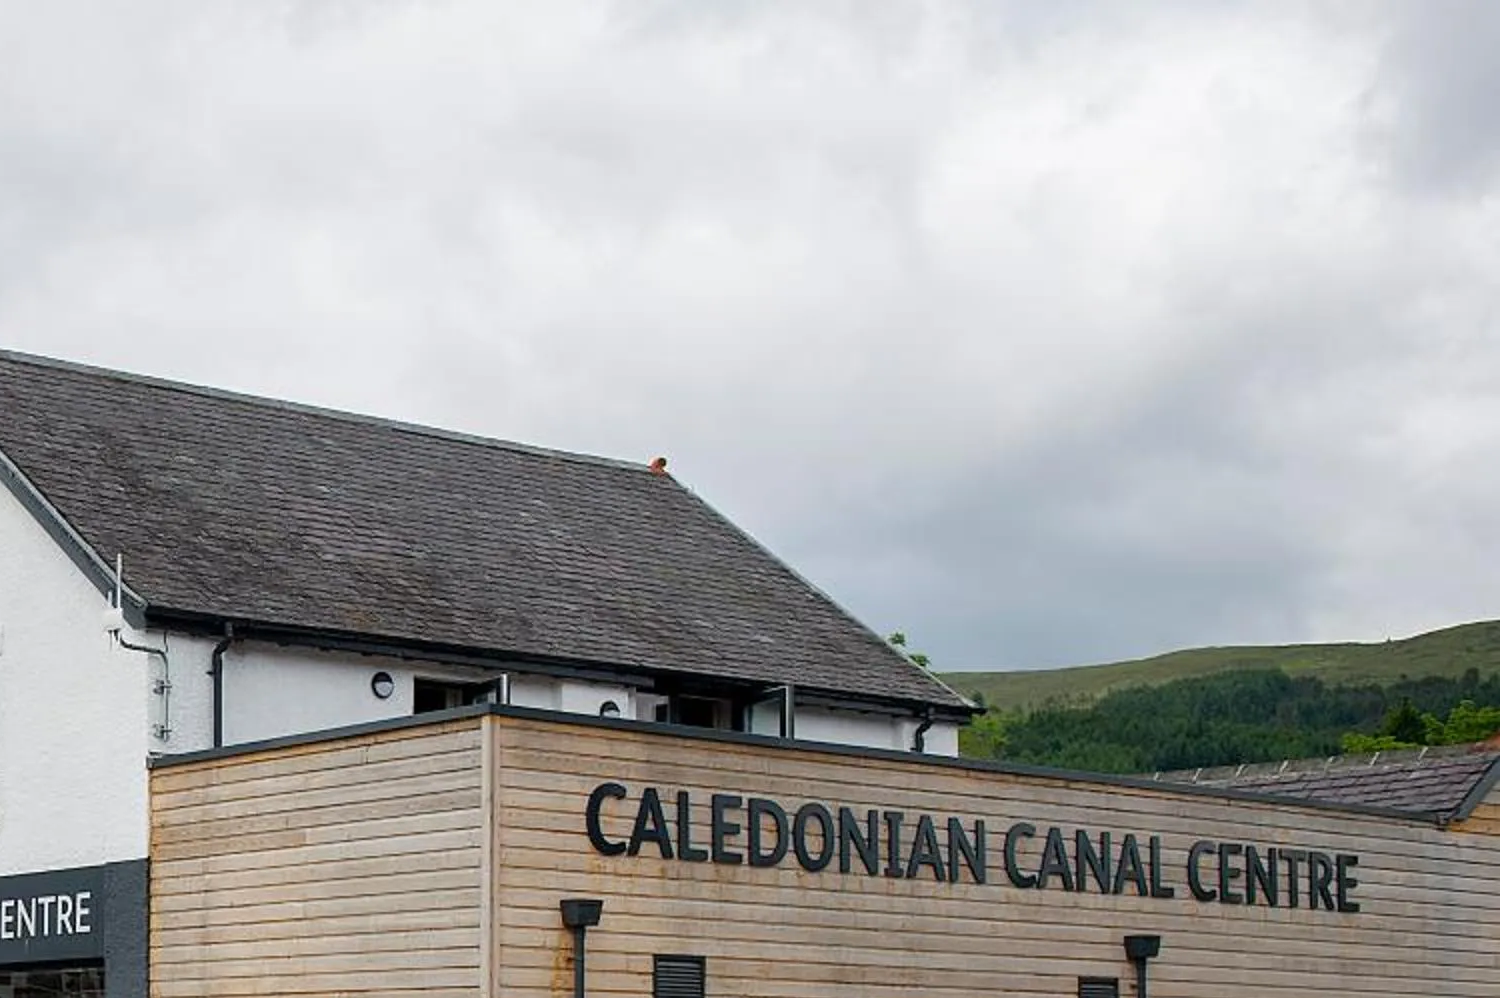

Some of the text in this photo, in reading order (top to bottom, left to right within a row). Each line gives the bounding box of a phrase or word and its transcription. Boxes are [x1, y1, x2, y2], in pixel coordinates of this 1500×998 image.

[585, 781, 1361, 913] CALEDONIAN CANAL CENTRE
